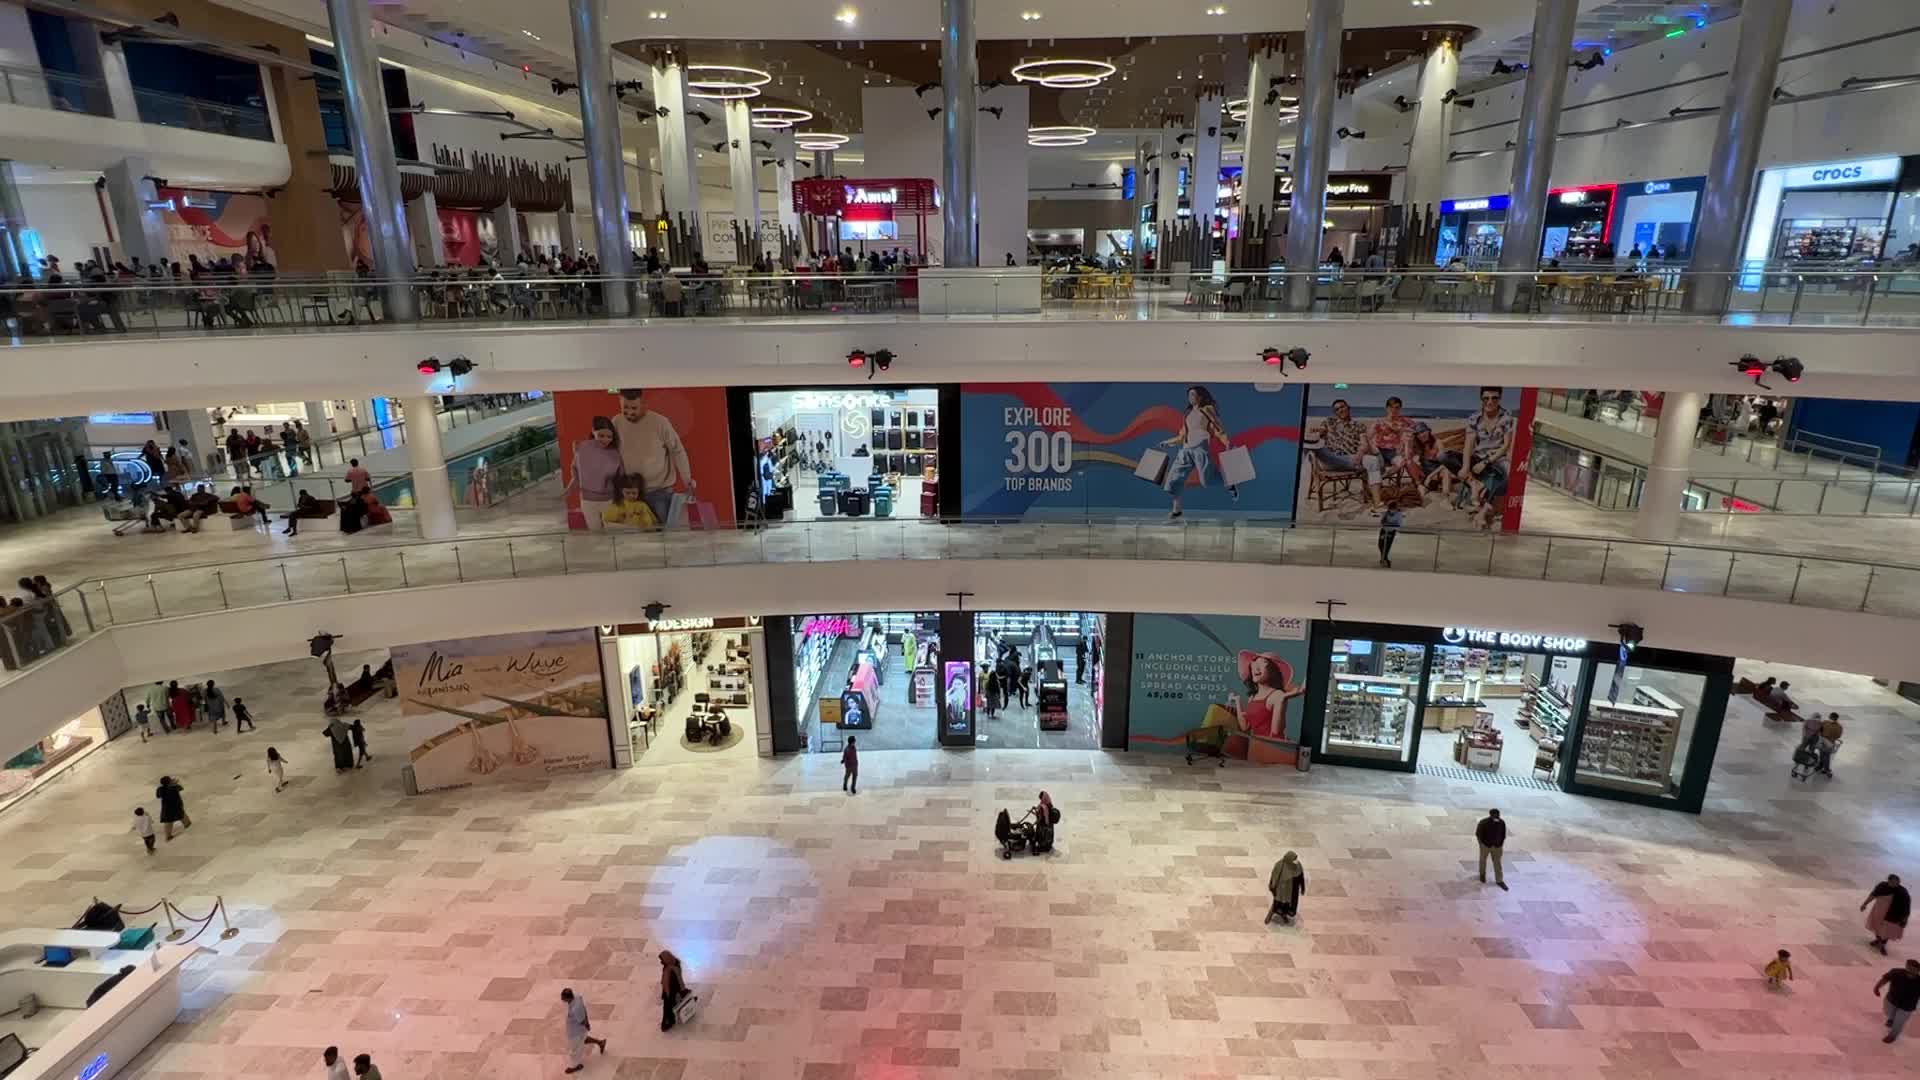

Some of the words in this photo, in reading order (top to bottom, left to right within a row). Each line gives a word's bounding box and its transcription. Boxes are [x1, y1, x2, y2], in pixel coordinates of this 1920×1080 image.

[1813, 166, 1862, 181] crocs
[853, 187, 897, 203] Amul
[1349, 184, 1369, 193] Free
[1004, 407, 1072, 426] EXPLORE
[1004, 430, 1072, 473] 300
[1005, 477, 1026, 491] TOP
[1028, 478, 1072, 492] BRANDS
[1466, 630, 1497, 644] THE
[1499, 632, 1541, 648] BODY
[1542, 636, 1586, 651] SHOP
[1148, 653, 1194, 662] ANCHOR
[1197, 655, 1238, 664] STORES
[419, 650, 463, 687] Mia
[1140, 662, 1200, 672] INCLUDING
[1203, 664, 1231, 673] LULU
[1145, 672, 1223, 682] HYPERMARKET
[1140, 681, 1182, 690] SPREAD
[1186, 683, 1228, 692] ACROSS
